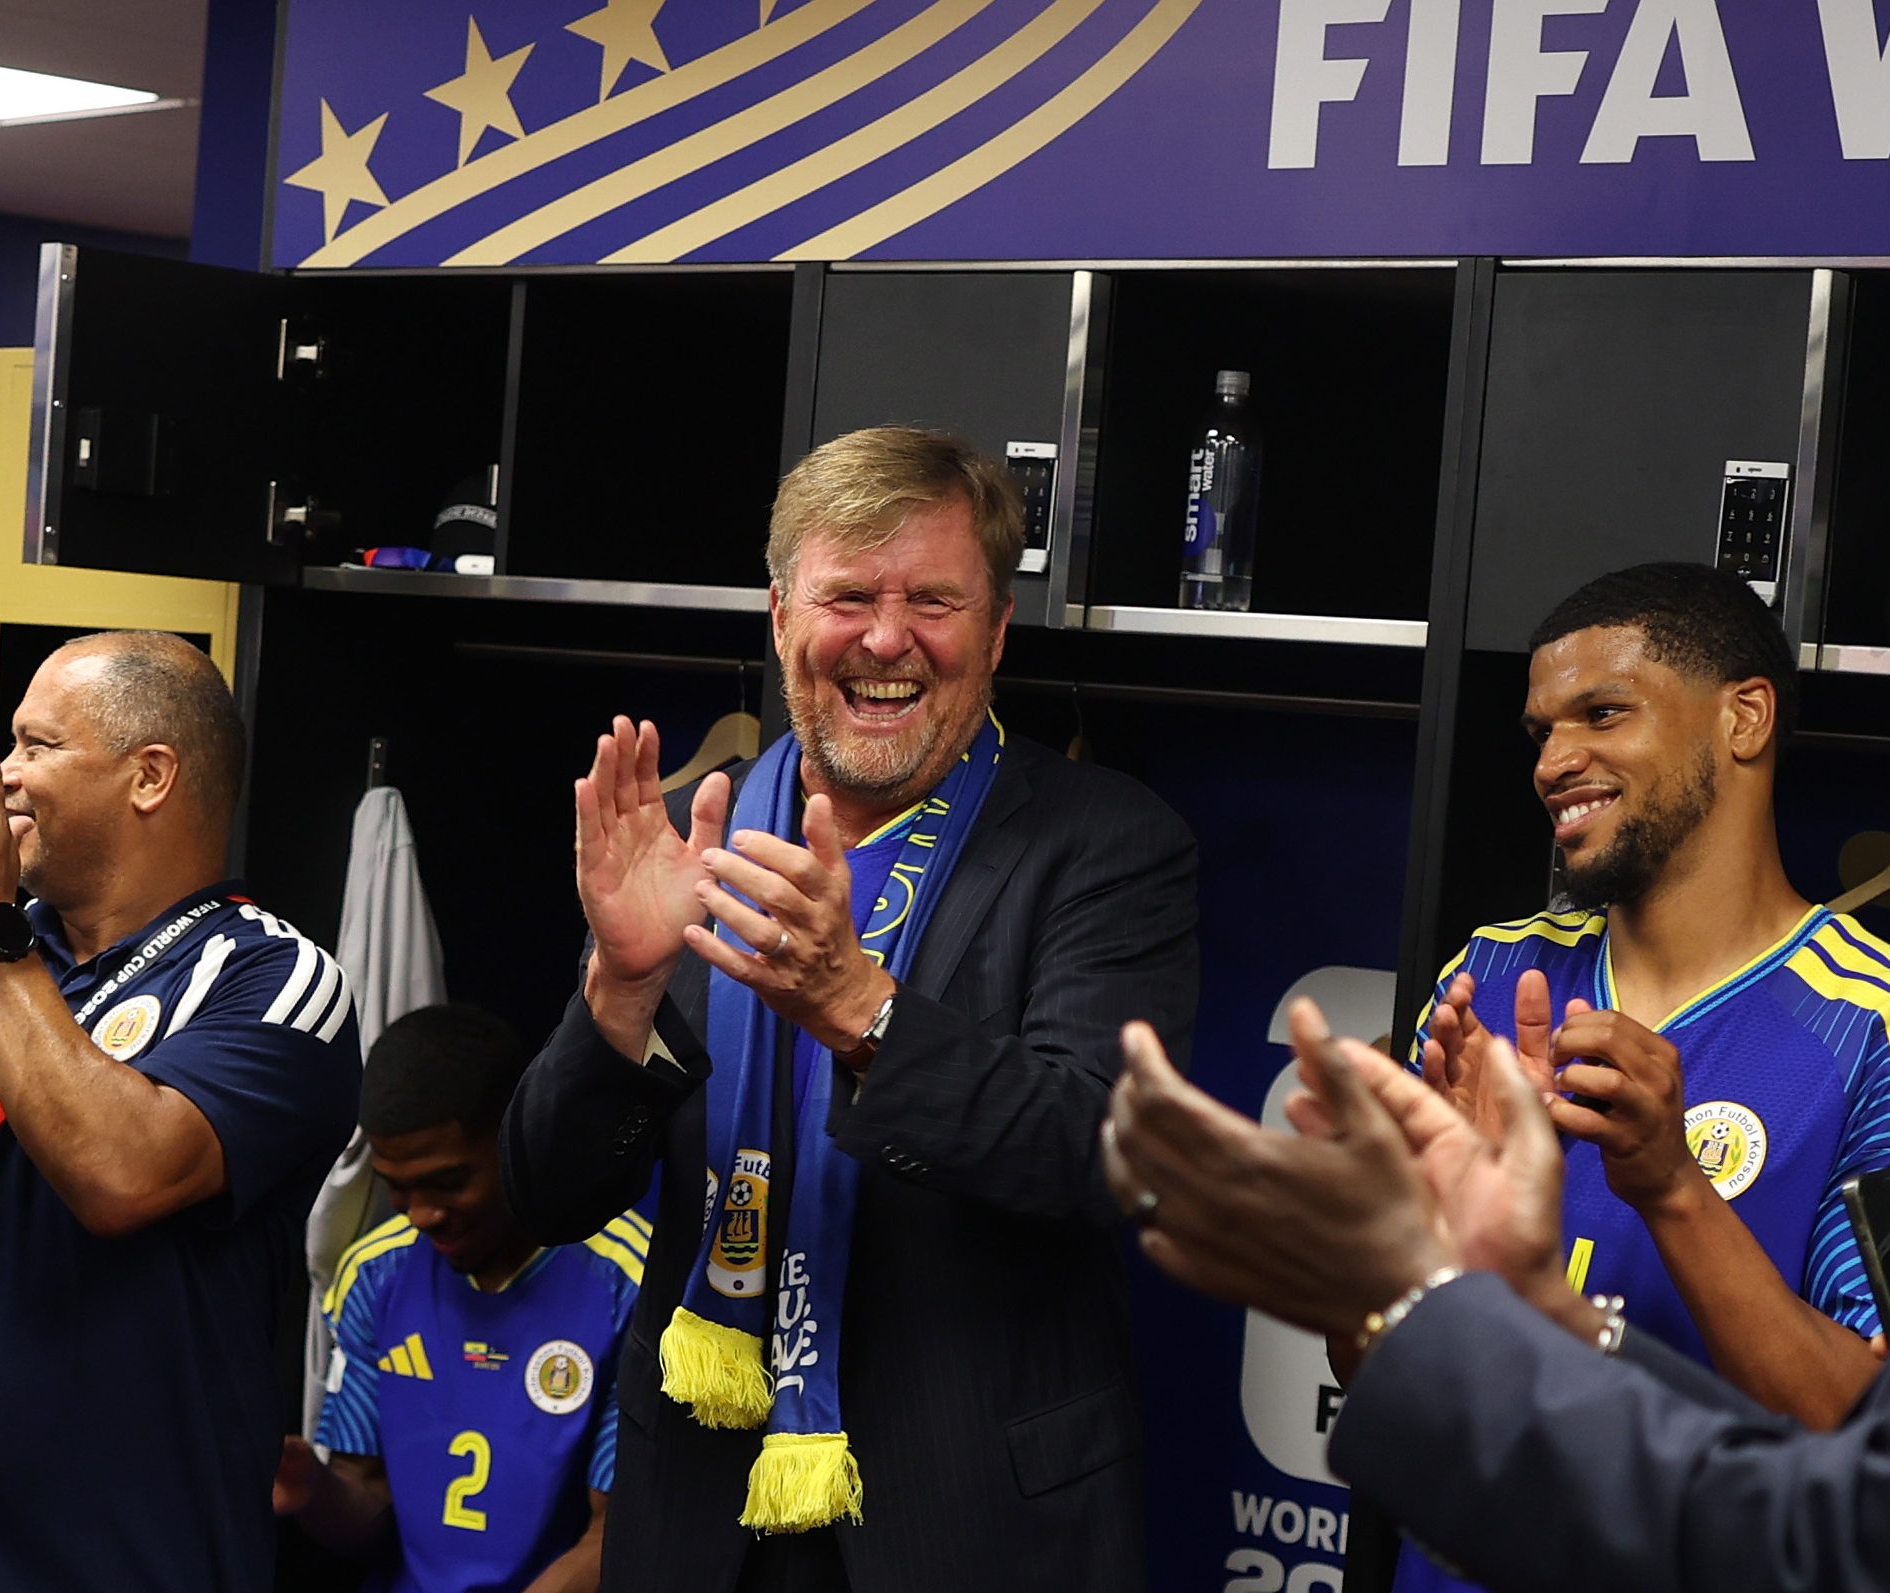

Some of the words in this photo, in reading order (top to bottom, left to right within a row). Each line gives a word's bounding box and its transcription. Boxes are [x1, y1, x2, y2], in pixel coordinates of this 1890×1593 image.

[1267, 0, 1756, 169] FIFA
[1202, 448, 1215, 492] water
[1185, 448, 1204, 542] smart
[187, 900, 221, 918] FIFA
[142, 916, 194, 959] WORLD
[117, 955, 146, 984] CUP
[442, 1430, 492, 1531] 2
